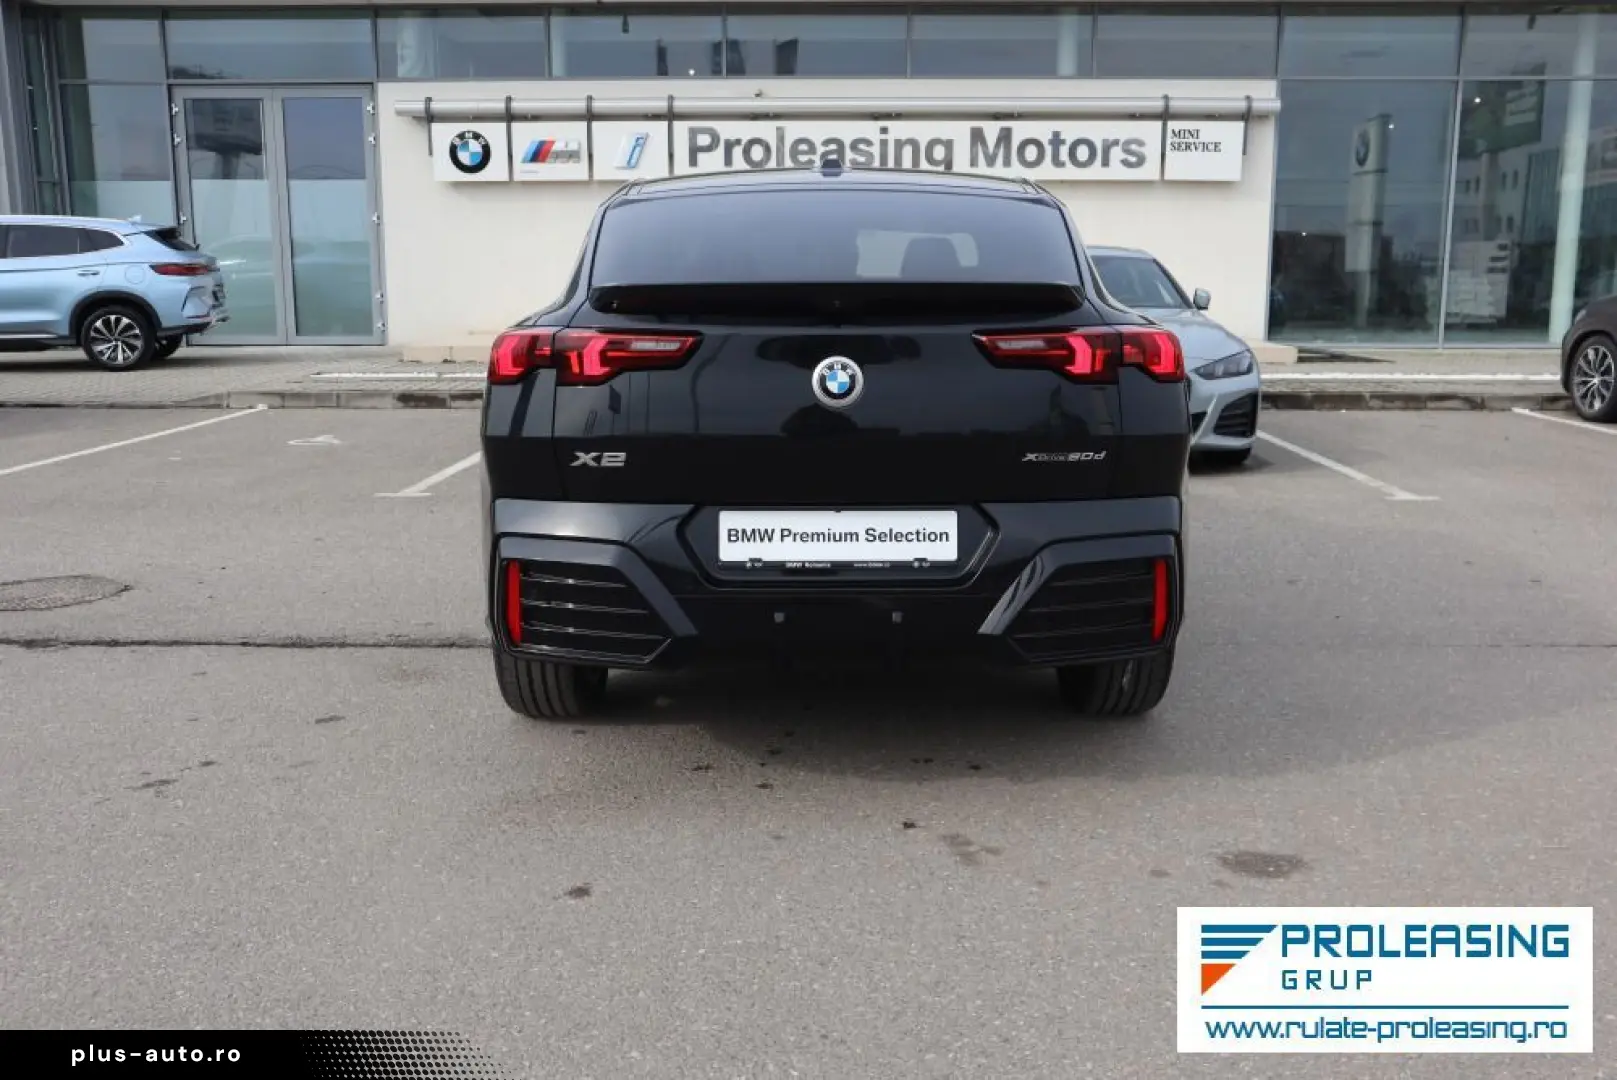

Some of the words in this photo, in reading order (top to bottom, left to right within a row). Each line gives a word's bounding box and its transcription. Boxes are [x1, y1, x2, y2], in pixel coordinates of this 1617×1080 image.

[1170, 128, 1201, 141] MINI
[688, 126, 954, 170] Proleasing
[969, 126, 1147, 169] Motors
[1169, 141, 1222, 153] SERVICE
[569, 451, 627, 467] X2
[727, 527, 774, 543] BMW
[780, 527, 859, 543] Premium
[864, 527, 950, 543] Selection
